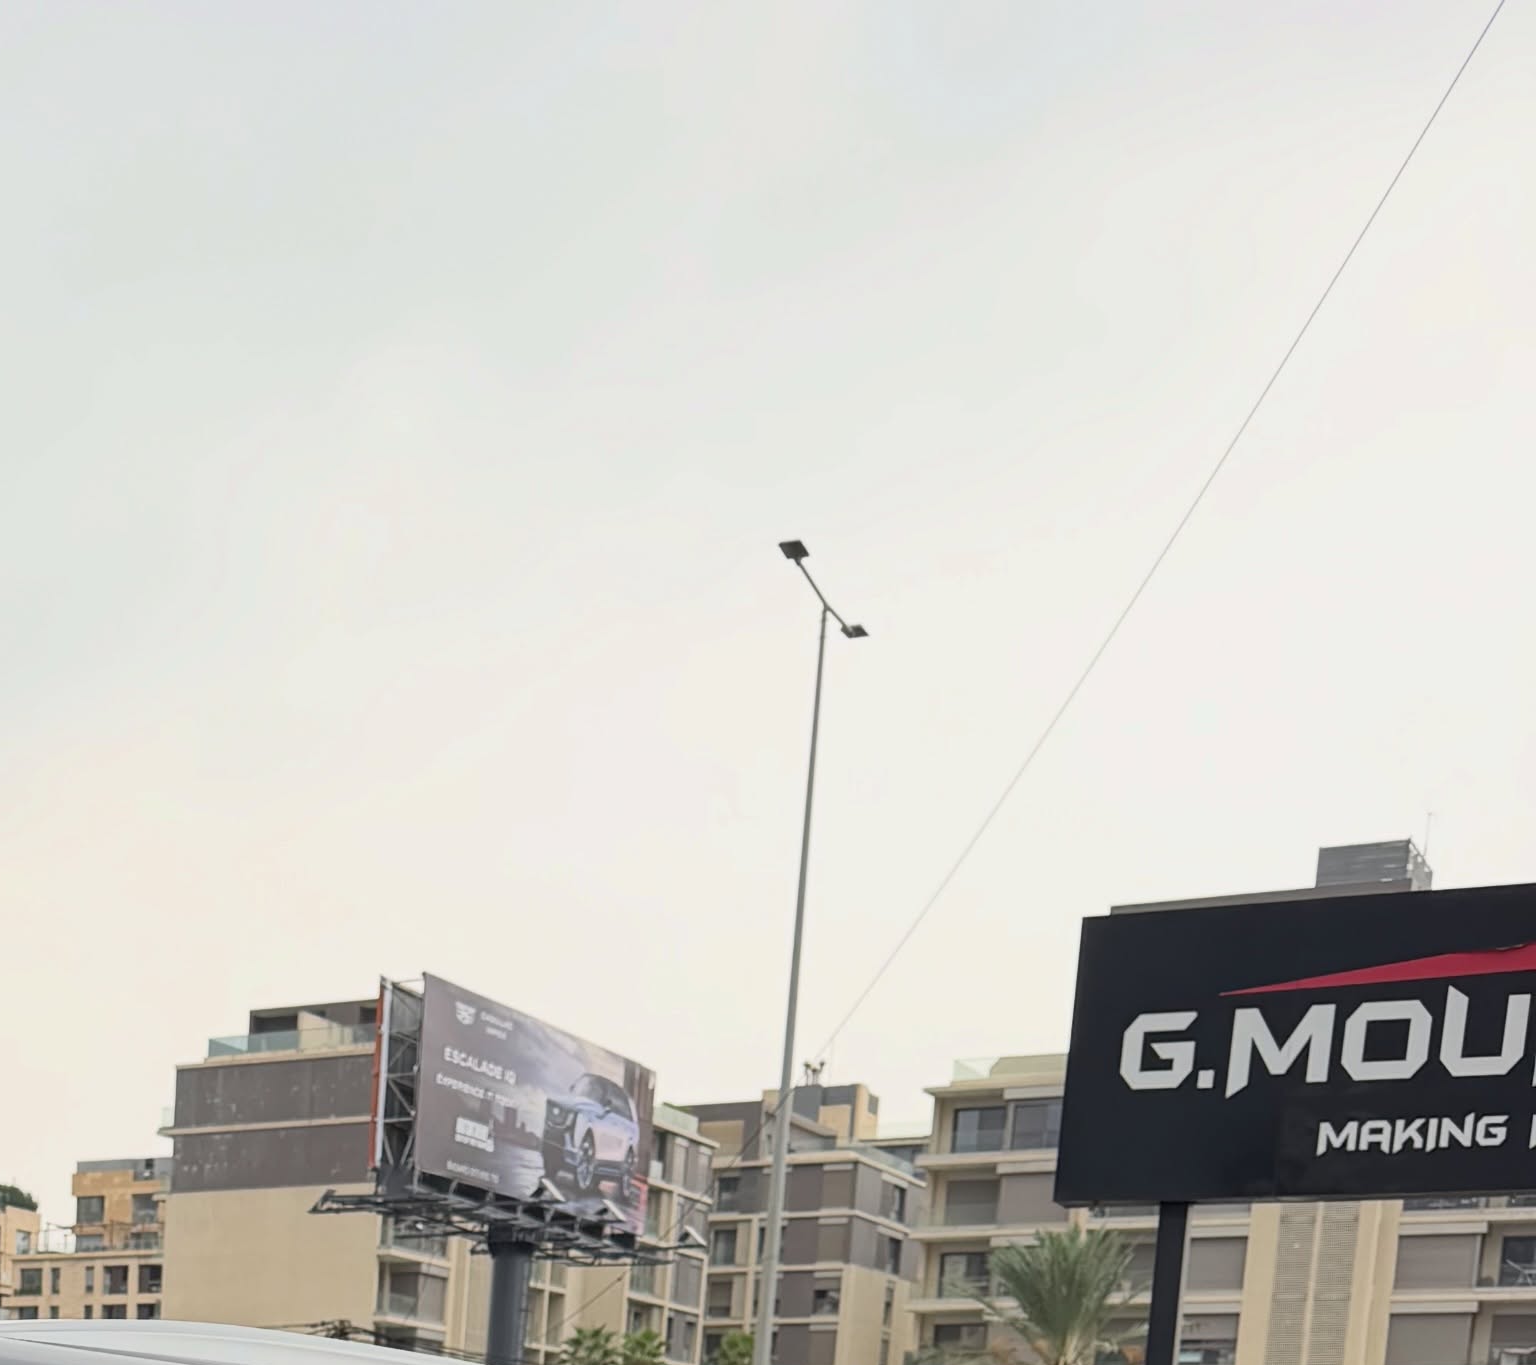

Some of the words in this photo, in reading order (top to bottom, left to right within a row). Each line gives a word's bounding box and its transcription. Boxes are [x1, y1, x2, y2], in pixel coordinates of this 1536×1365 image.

[444, 1046, 503, 1080] ESCALADE
[1119, 985, 1536, 1100] G.MOU
[1316, 1112, 1510, 1157] MAKING
